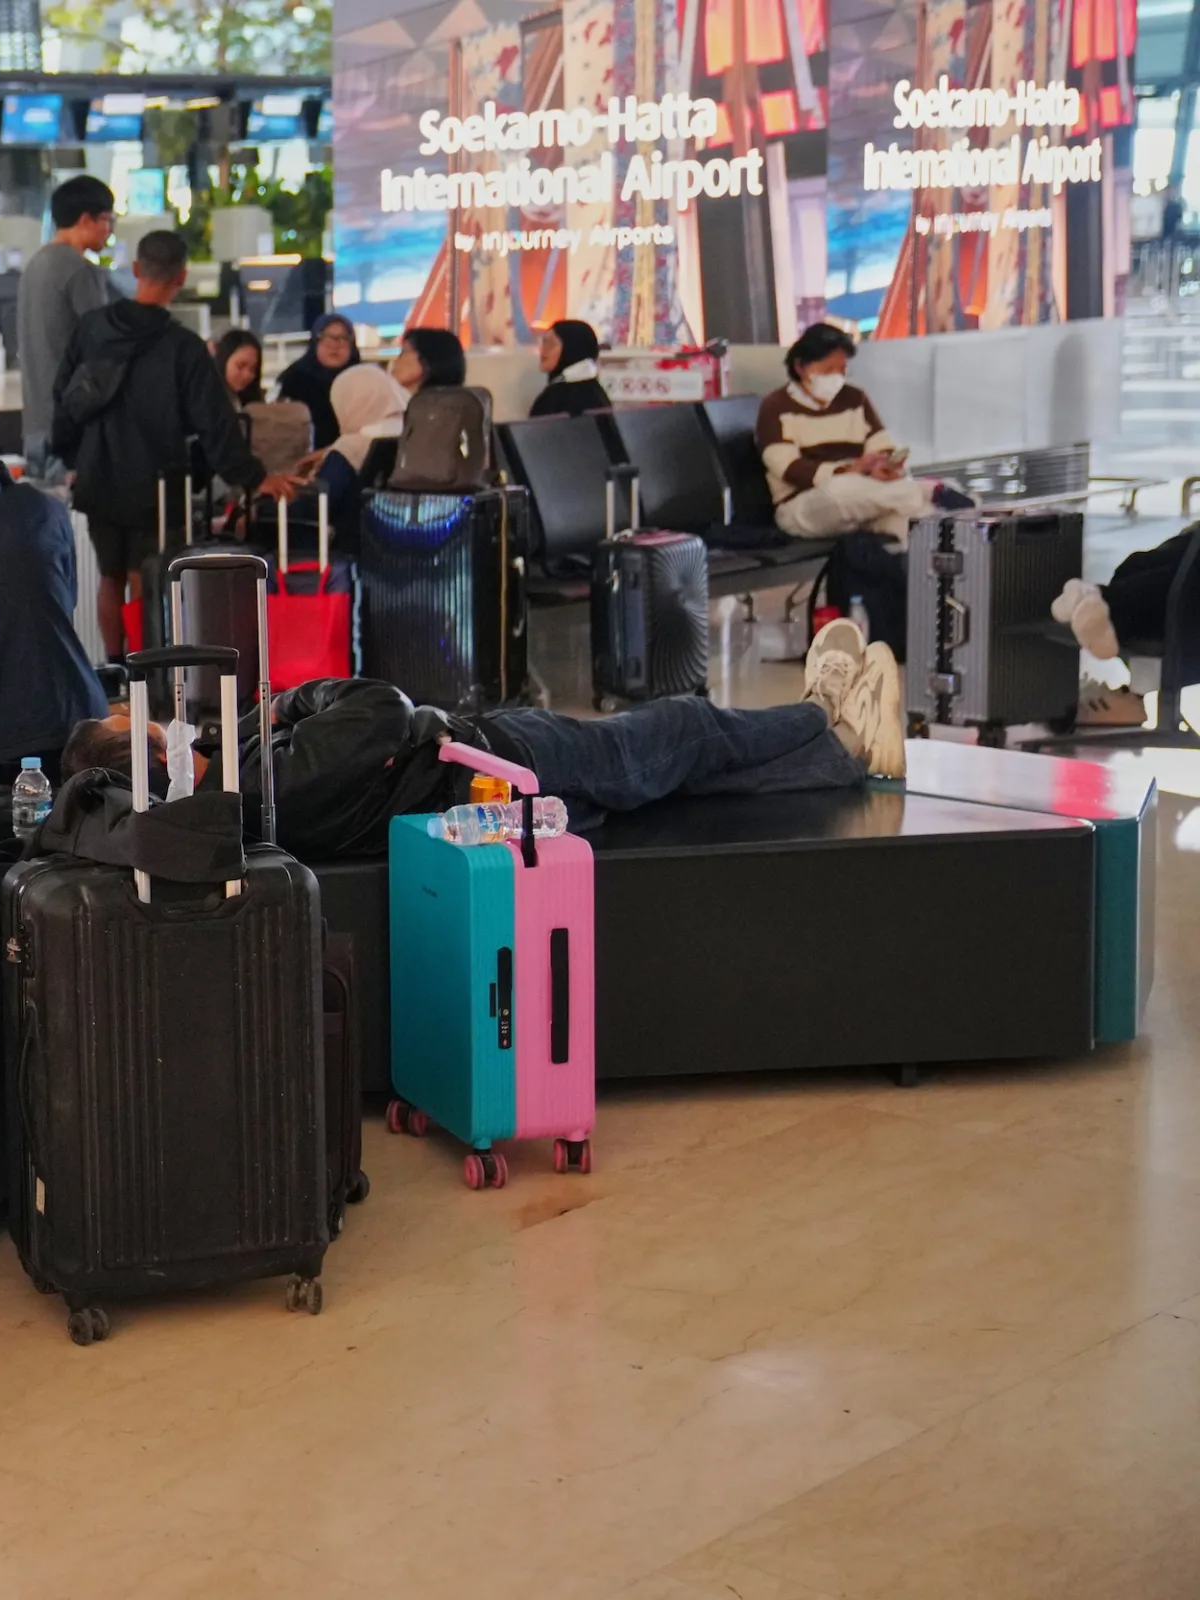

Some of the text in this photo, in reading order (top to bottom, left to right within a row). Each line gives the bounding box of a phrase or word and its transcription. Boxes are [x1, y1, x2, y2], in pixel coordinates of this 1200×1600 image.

[419, 92, 718, 156] Soekarno-Hatta
[893, 74, 1080, 129] Soekarno-Hatta
[380, 148, 763, 212] International Airport
[864, 134, 1102, 195] International Airport
[454, 231, 476, 252] by
[589, 223, 675, 250] Airports
